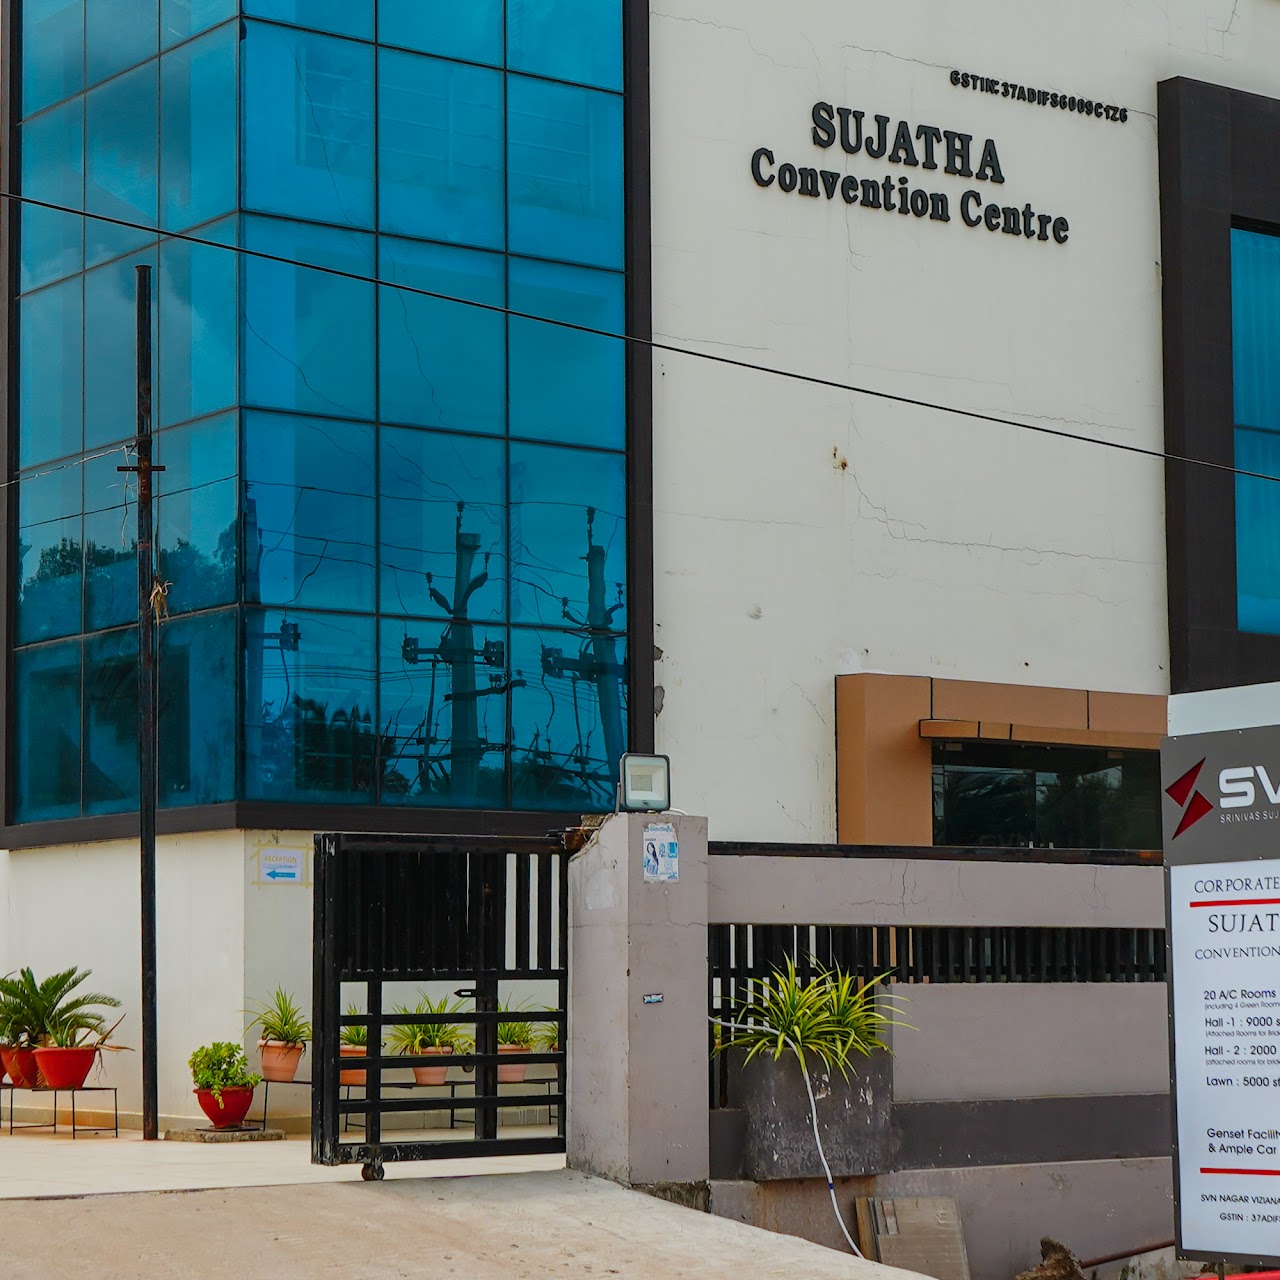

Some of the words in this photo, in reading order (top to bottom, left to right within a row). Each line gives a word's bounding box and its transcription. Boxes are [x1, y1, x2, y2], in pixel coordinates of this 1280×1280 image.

[811, 101, 1005, 184] SUJATHA
[751, 147, 950, 222] Convention
[960, 190, 1069, 244] Centre
[1220, 811, 1261, 824] SRINIVAS
[1194, 876, 1280, 894] CORPORATE
[1194, 946, 1280, 960] CONVENTION
[1203, 990, 1217, 1000] 20
[1219, 989, 1237, 1000] A/C
[1240, 989, 1277, 999] Rooms
[1205, 1017, 1224, 1027] Hall
[1246, 1016, 1273, 1027] 9000
[1205, 1046, 1224, 1055] Hall
[1233, 1045, 1240, 1055] 2
[1250, 1045, 1277, 1055] 2000
[1206, 1076, 1233, 1086] Lawn
[1242, 1076, 1270, 1087] 5000
[1207, 1128, 1244, 1139] Genset
[1208, 1143, 1217, 1153] &
[1219, 1144, 1253, 1155] Ample
[1256, 1144, 1276, 1155] Car
[1200, 1194, 1217, 1202] SVN
[1219, 1195, 1249, 1203] NAGAR
[1220, 1213, 1243, 1221] GSTIN
